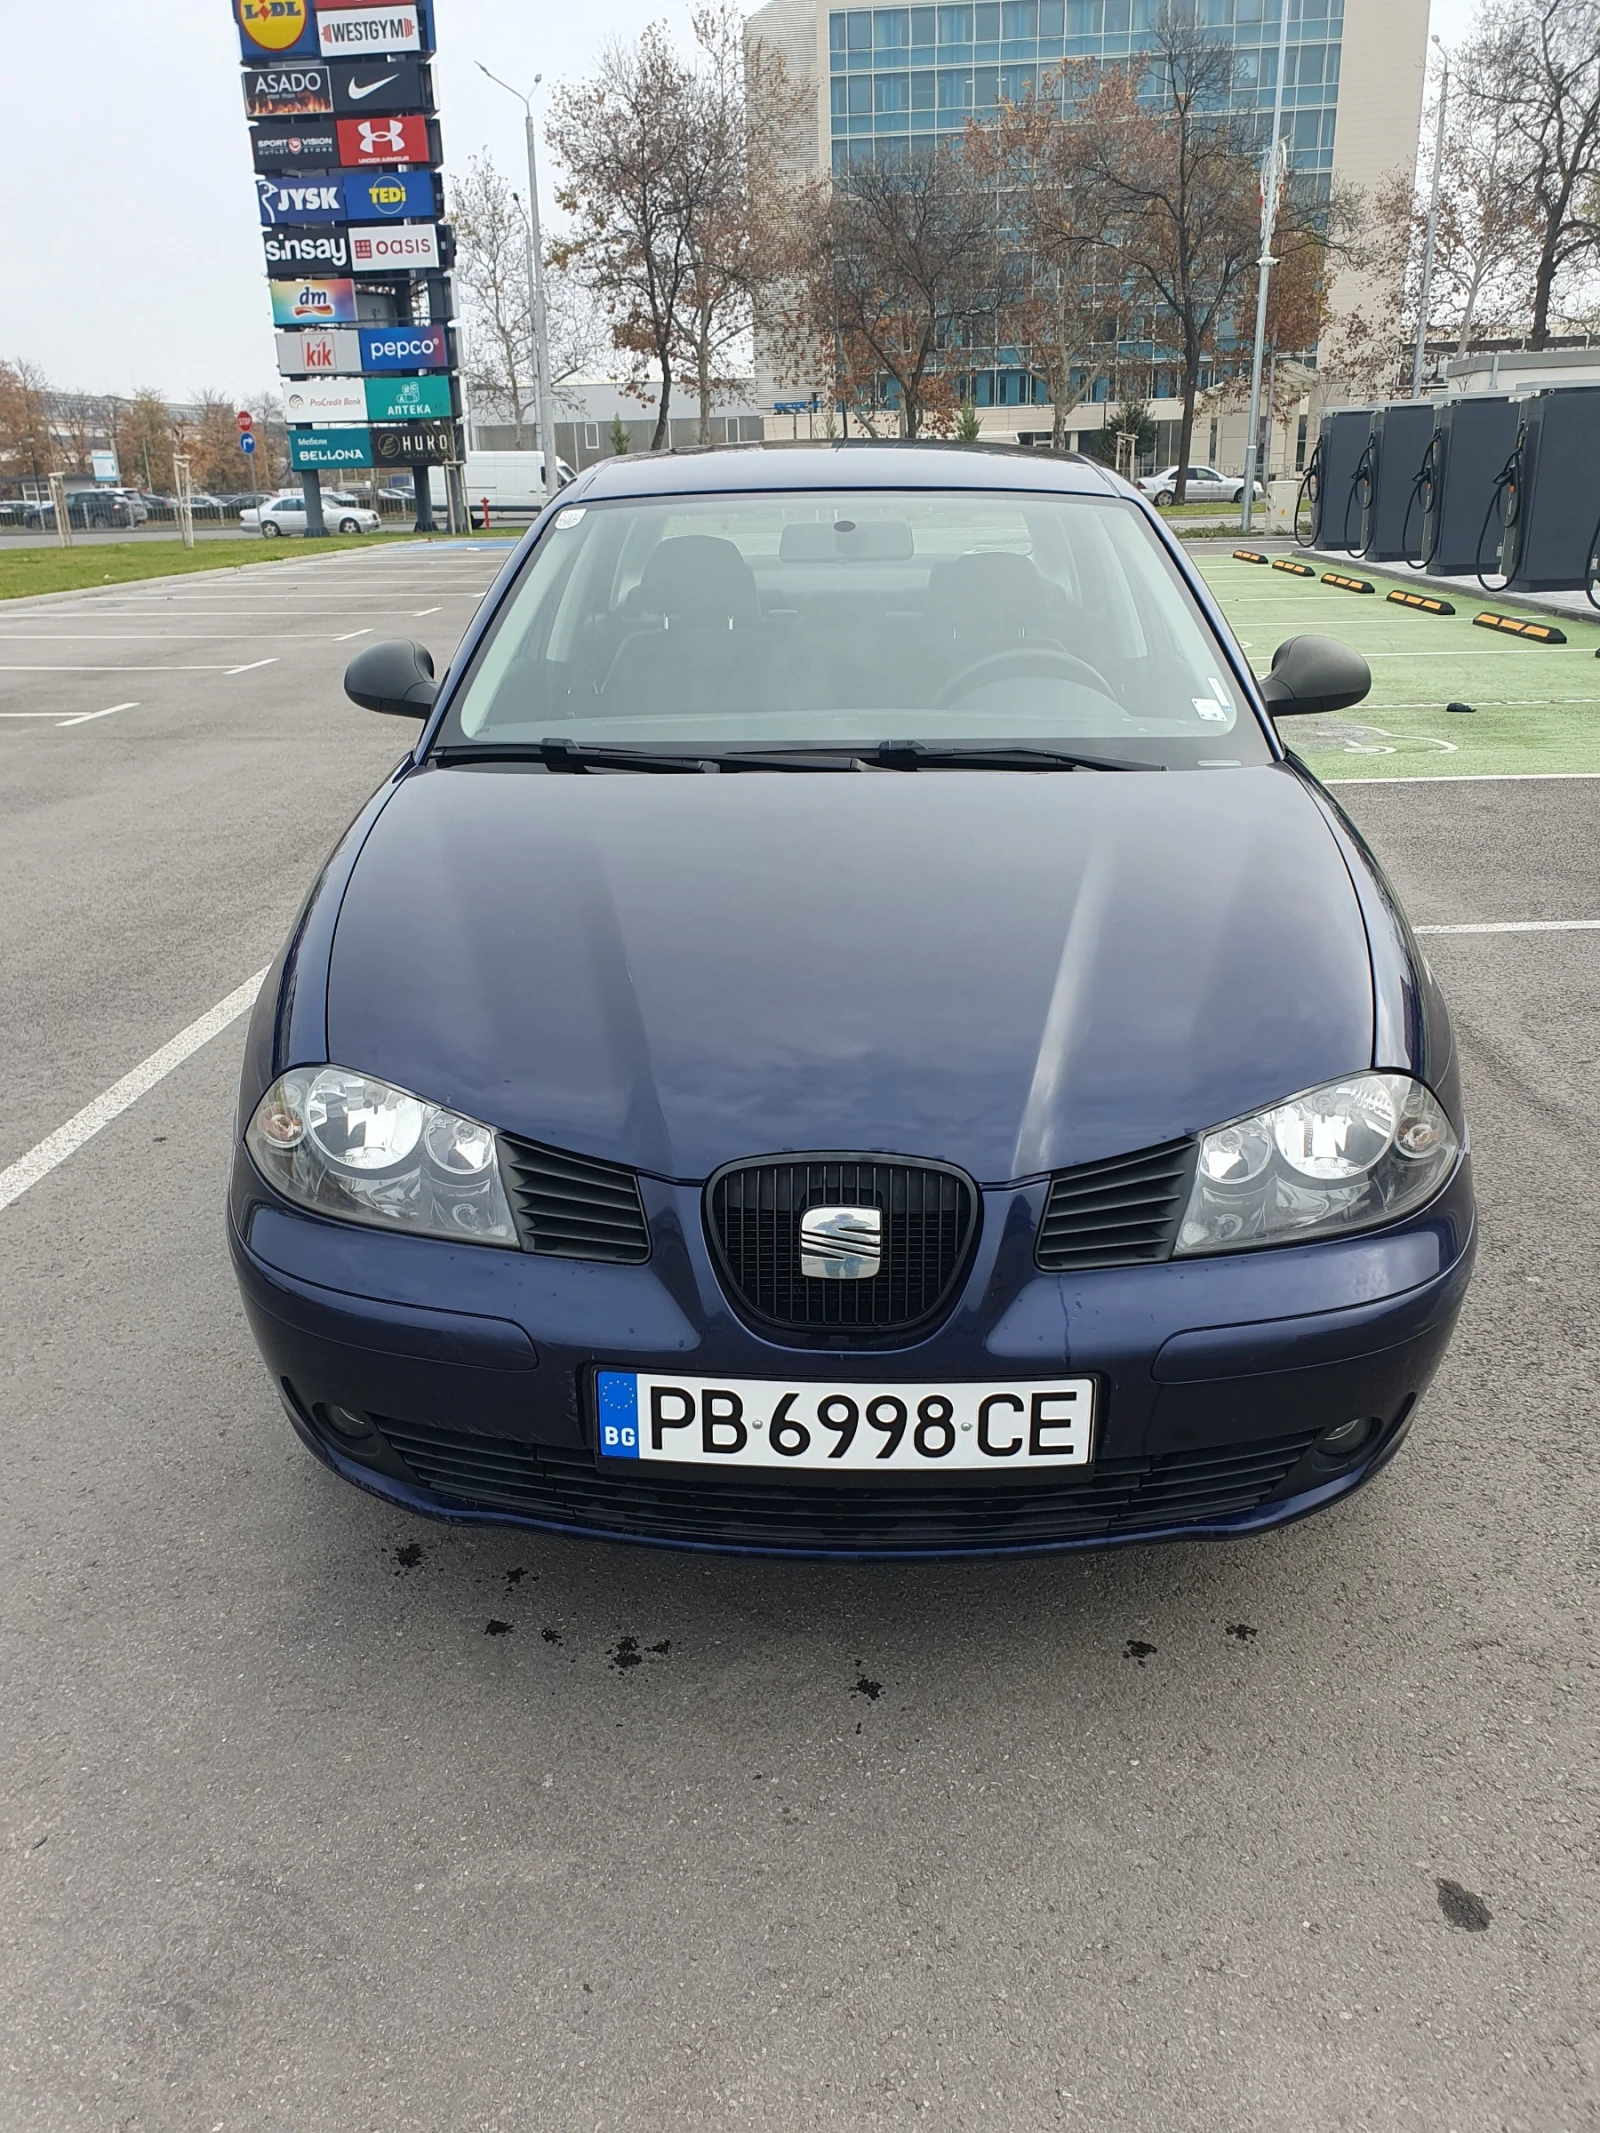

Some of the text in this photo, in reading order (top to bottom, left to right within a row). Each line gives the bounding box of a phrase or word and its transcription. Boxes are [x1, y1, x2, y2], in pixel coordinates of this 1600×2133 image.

[331, 18, 405, 43] WESTGYM
[255, 72, 321, 94] ASADO
[257, 137, 333, 148] SPORT VISION
[258, 146, 333, 156] OUTLET STORE
[277, 186, 340, 212] JYSK
[368, 186, 407, 204] TEDi
[265, 233, 347, 267] sinsay
[375, 238, 431, 255] oasis
[299, 286, 327, 306] dm
[370, 339, 434, 361] pepco
[310, 397, 361, 407] ProCredit Bank
[387, 404, 431, 416] АПТЕКА
[298, 437, 328, 446] Мебели
[299, 448, 364, 461] BELLONA
[650, 1384, 1079, 1459] PB 6998 CE
[604, 1425, 636, 1447] BG
